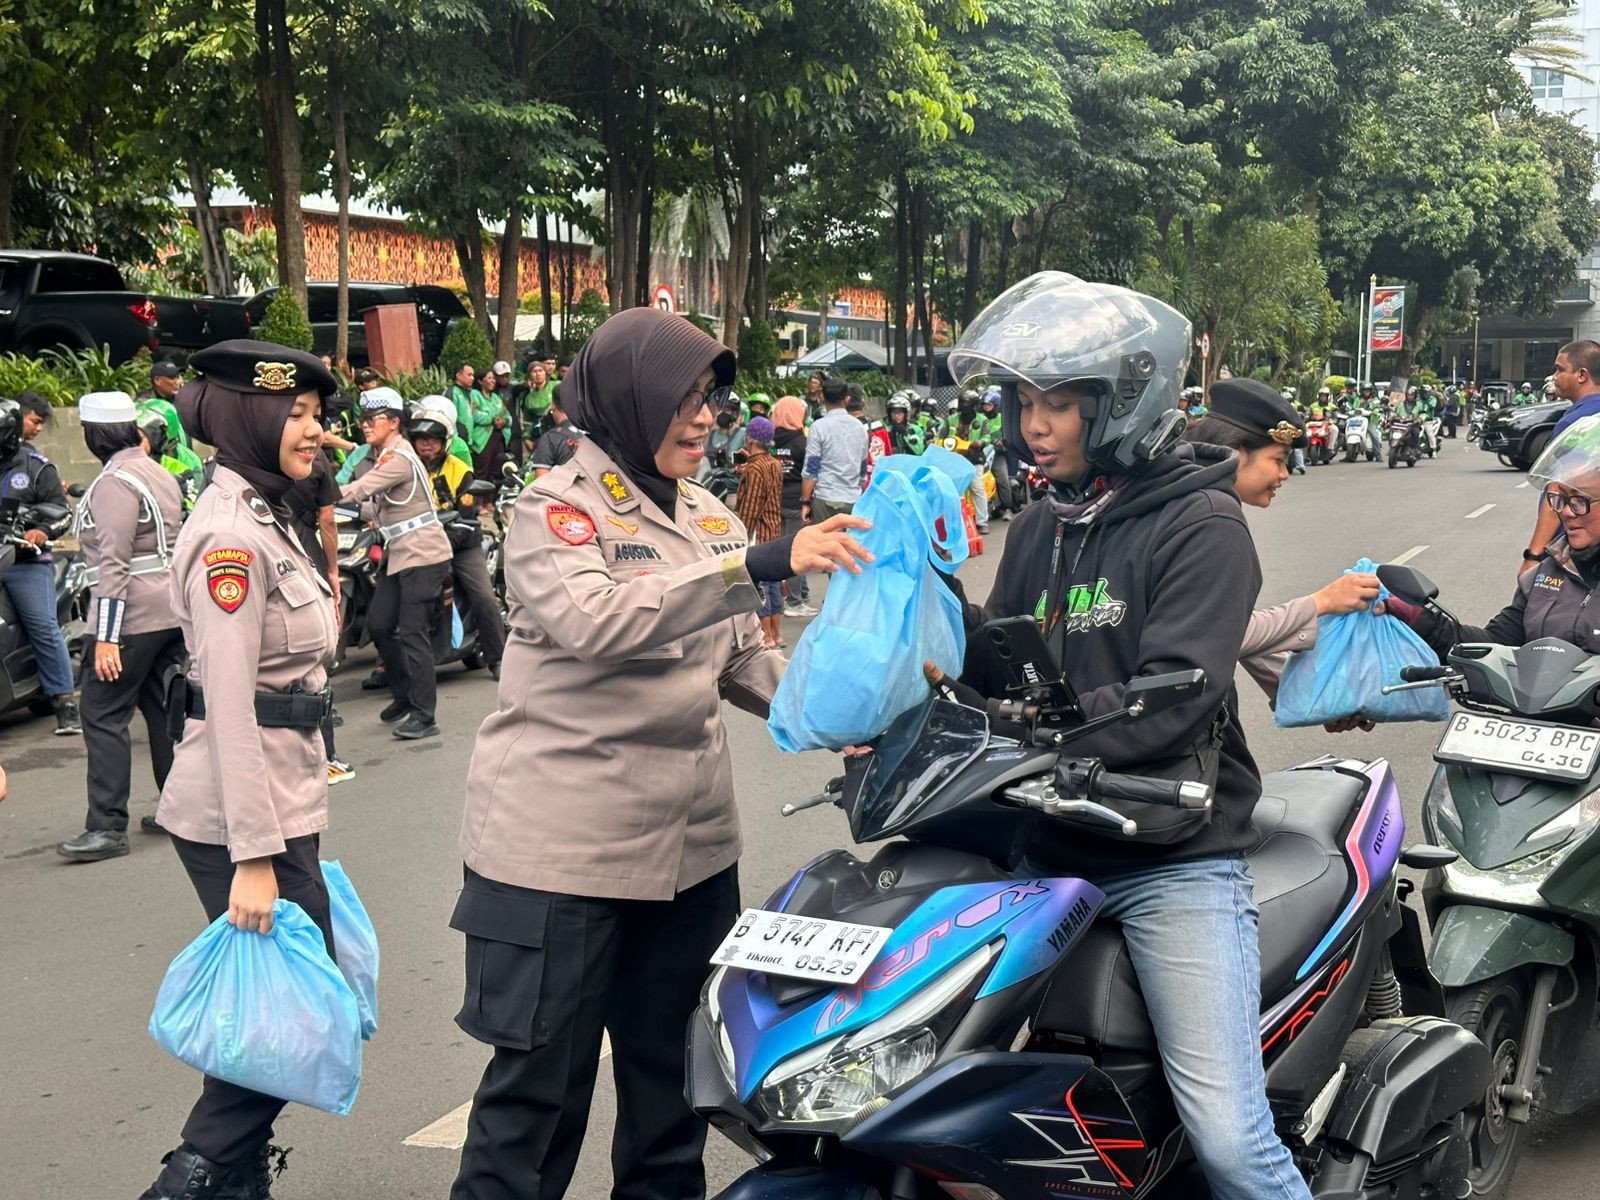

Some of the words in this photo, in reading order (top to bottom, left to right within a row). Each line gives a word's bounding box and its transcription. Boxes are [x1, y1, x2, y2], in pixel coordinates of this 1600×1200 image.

[1532, 645, 1566, 653] HONDA
[1454, 716, 1469, 732] B
[1550, 731, 1596, 751] BPC
[734, 913, 757, 938] B
[763, 917, 826, 947] 5747
[829, 926, 880, 956] KFI
[1046, 896, 1092, 952] YAMAHA
[1045, 1182, 1081, 1192] SPECIAL
[1087, 1187, 1121, 1196] EDITION
